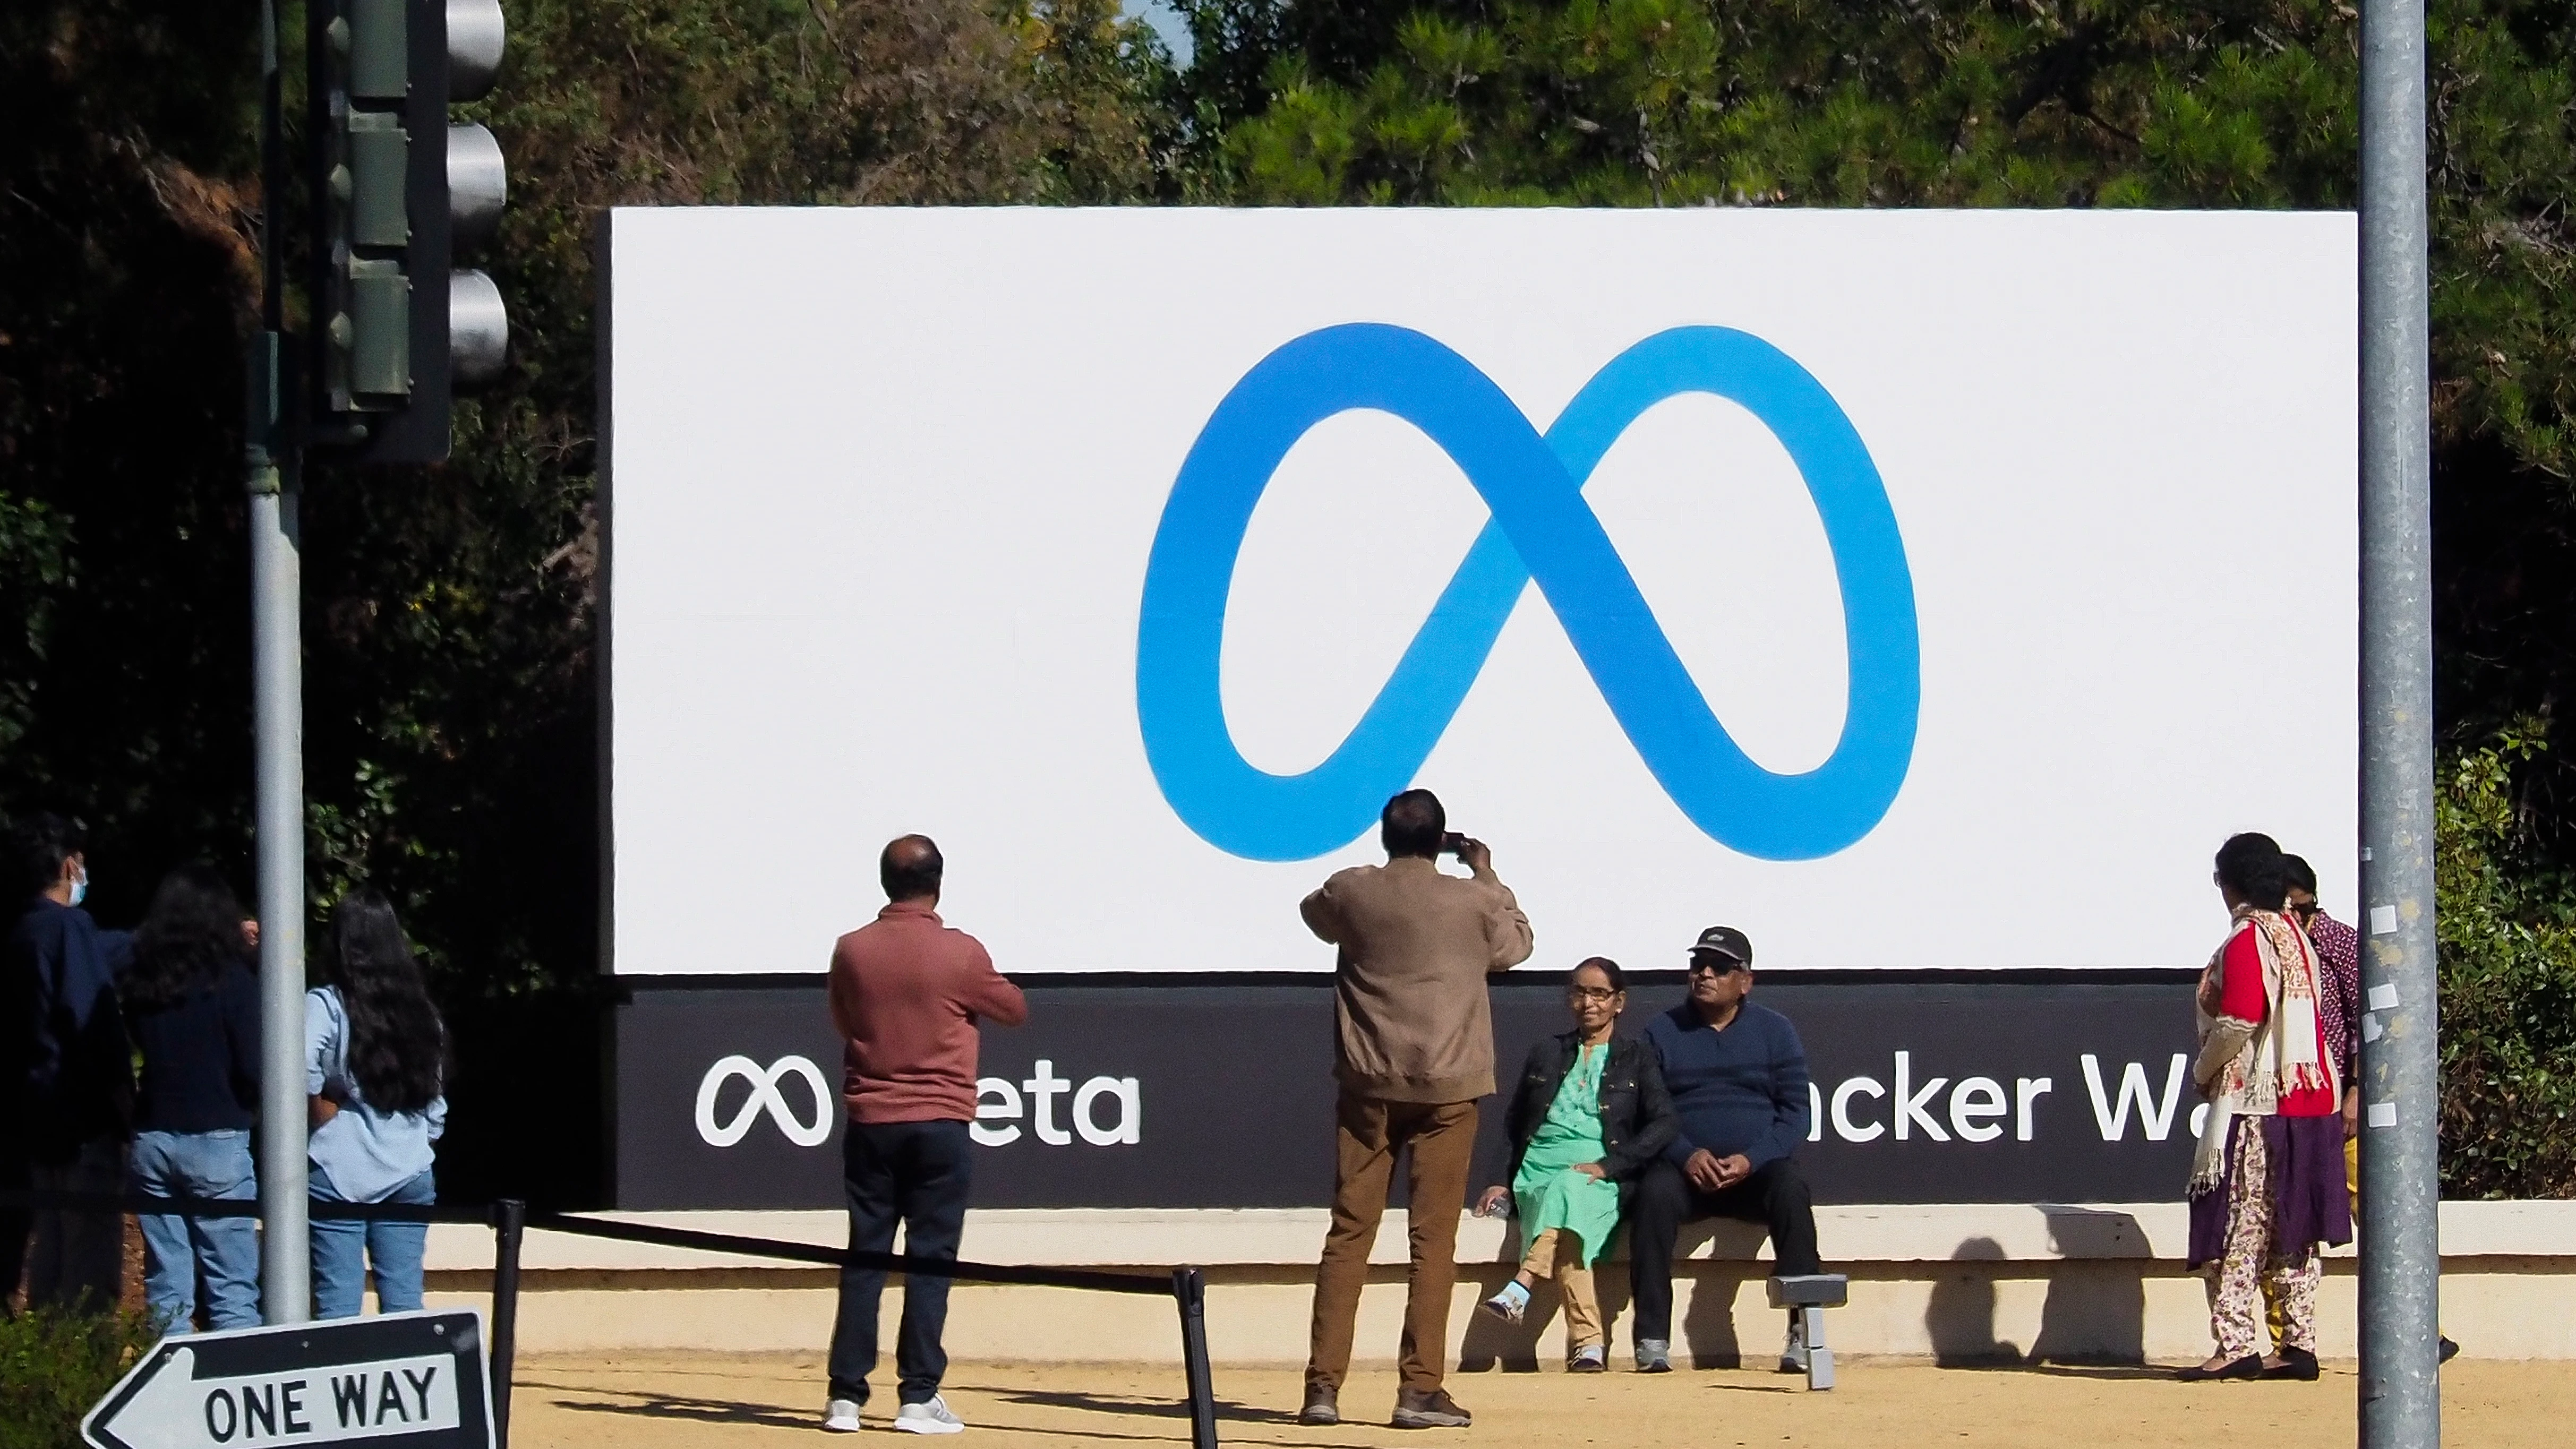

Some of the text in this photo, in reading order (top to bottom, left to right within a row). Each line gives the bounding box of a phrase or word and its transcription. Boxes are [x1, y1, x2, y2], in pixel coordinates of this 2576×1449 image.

[969, 1059, 1141, 1147] eta
[1805, 1050, 2052, 1142] cker
[204, 1366, 437, 1444] ONE WAY
